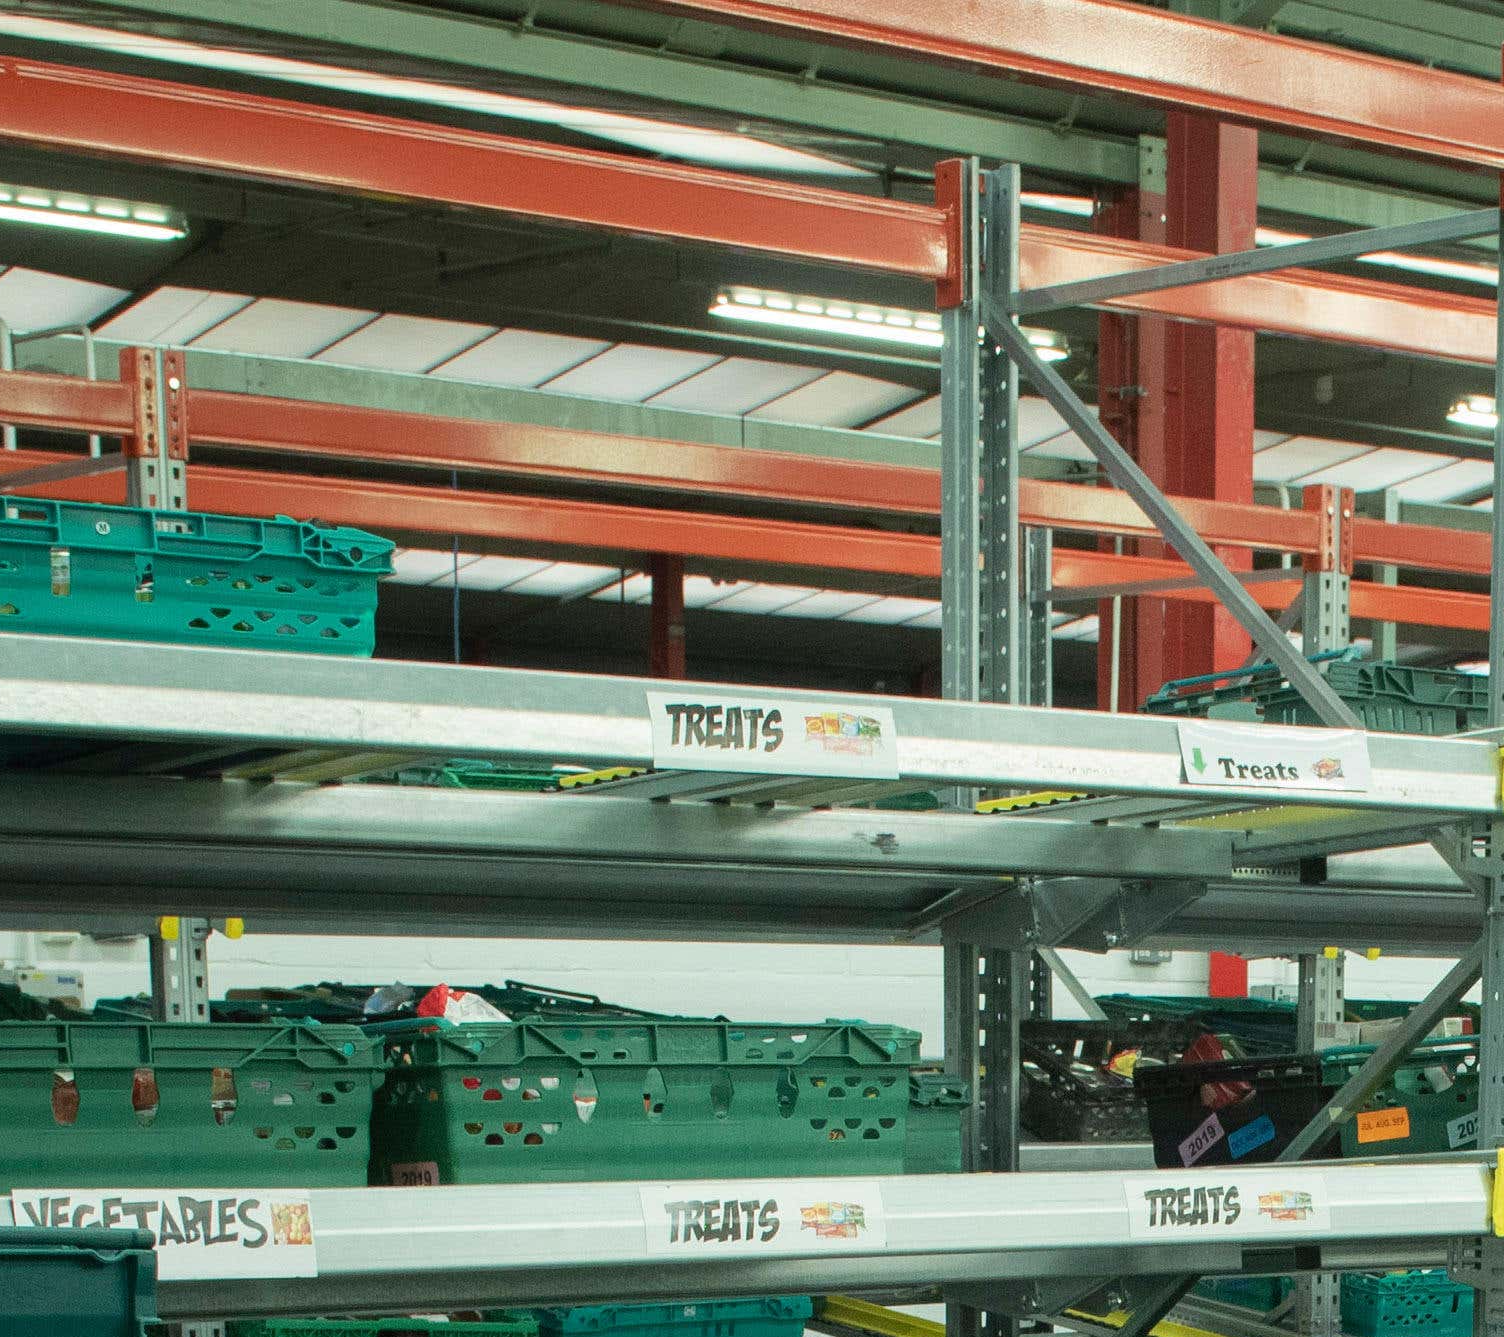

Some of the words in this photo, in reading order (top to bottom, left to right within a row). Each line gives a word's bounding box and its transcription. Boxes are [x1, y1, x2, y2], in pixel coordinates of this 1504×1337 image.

[665, 702, 785, 753] TREATS
[1217, 757, 1300, 781] Treats
[1188, 1124, 1217, 1158] 2019
[665, 1198, 781, 1243] TREATS
[1144, 1186, 1242, 1228] TREATS
